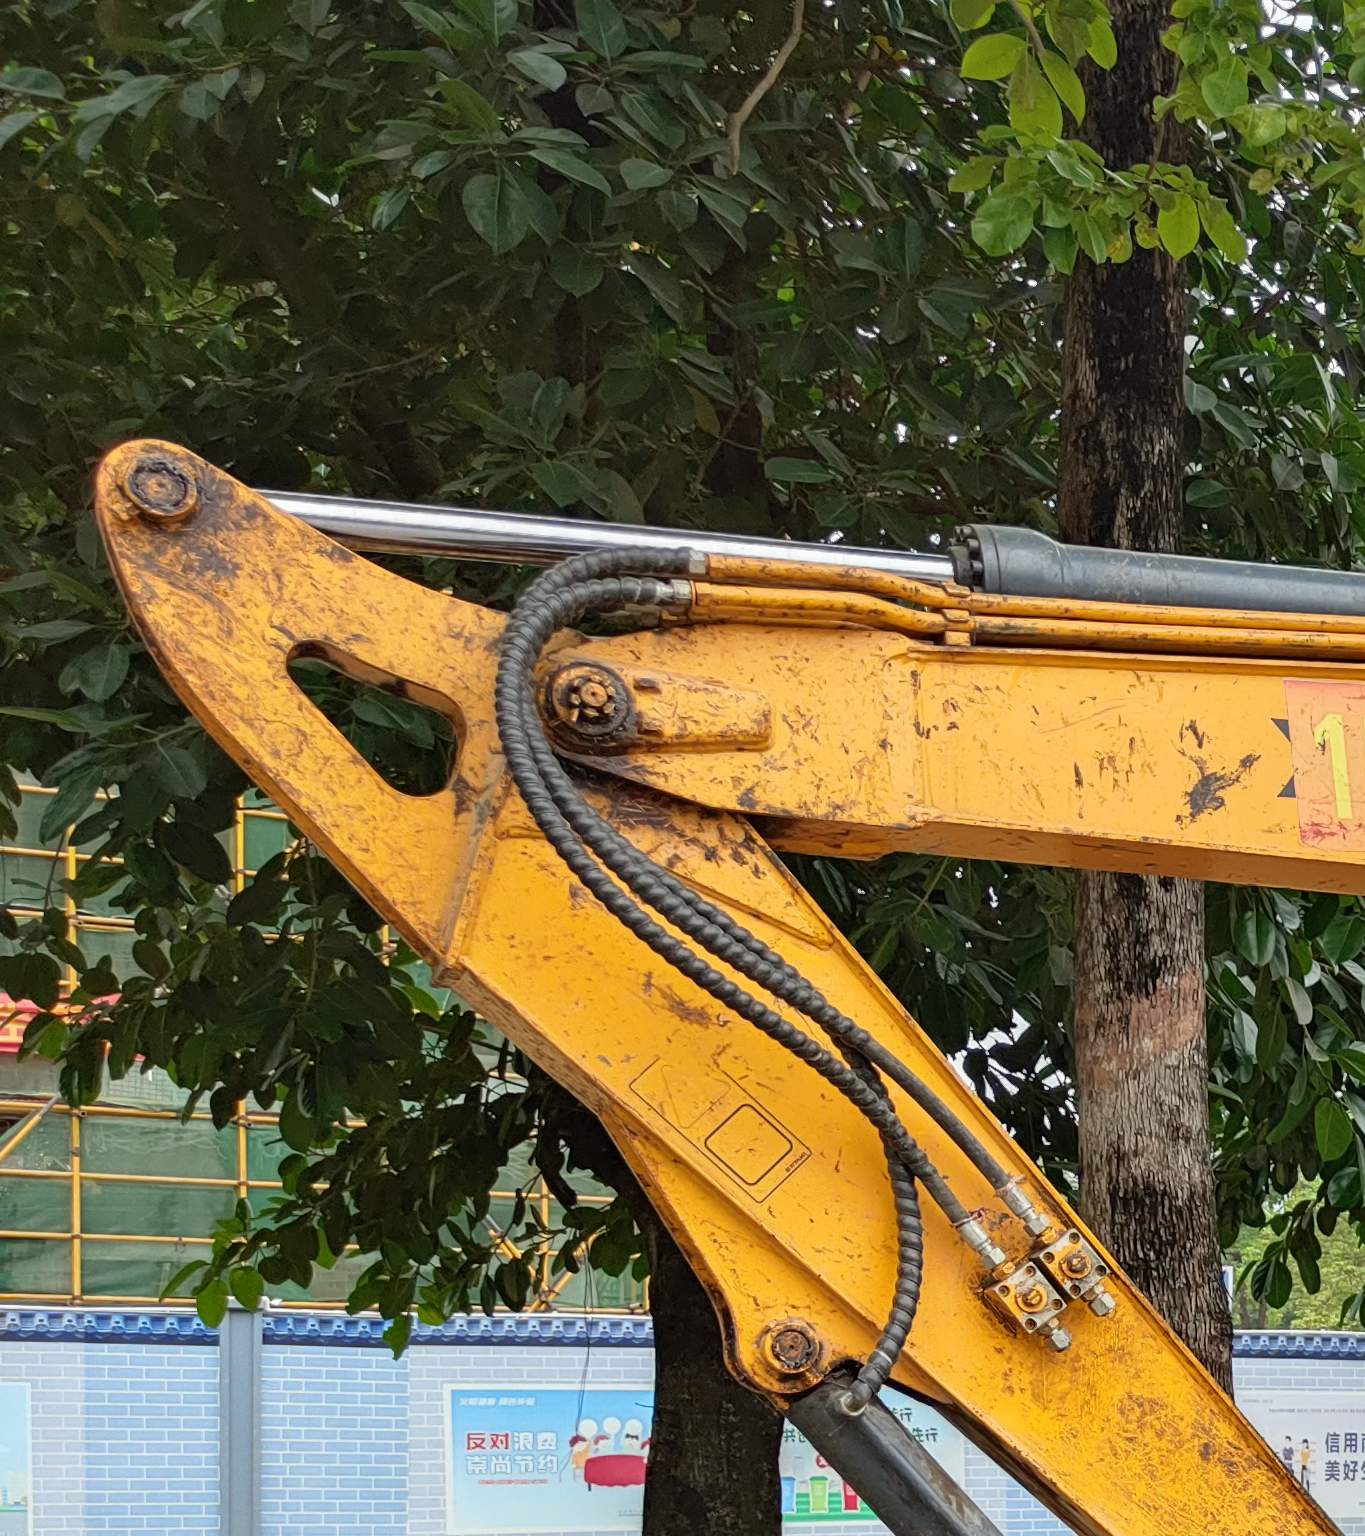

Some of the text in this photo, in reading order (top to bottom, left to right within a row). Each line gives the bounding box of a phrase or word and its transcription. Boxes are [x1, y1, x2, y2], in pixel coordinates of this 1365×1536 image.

[466, 1431, 558, 1451] 反对浪费
[465, 1455, 558, 1475] 崇尚节约
